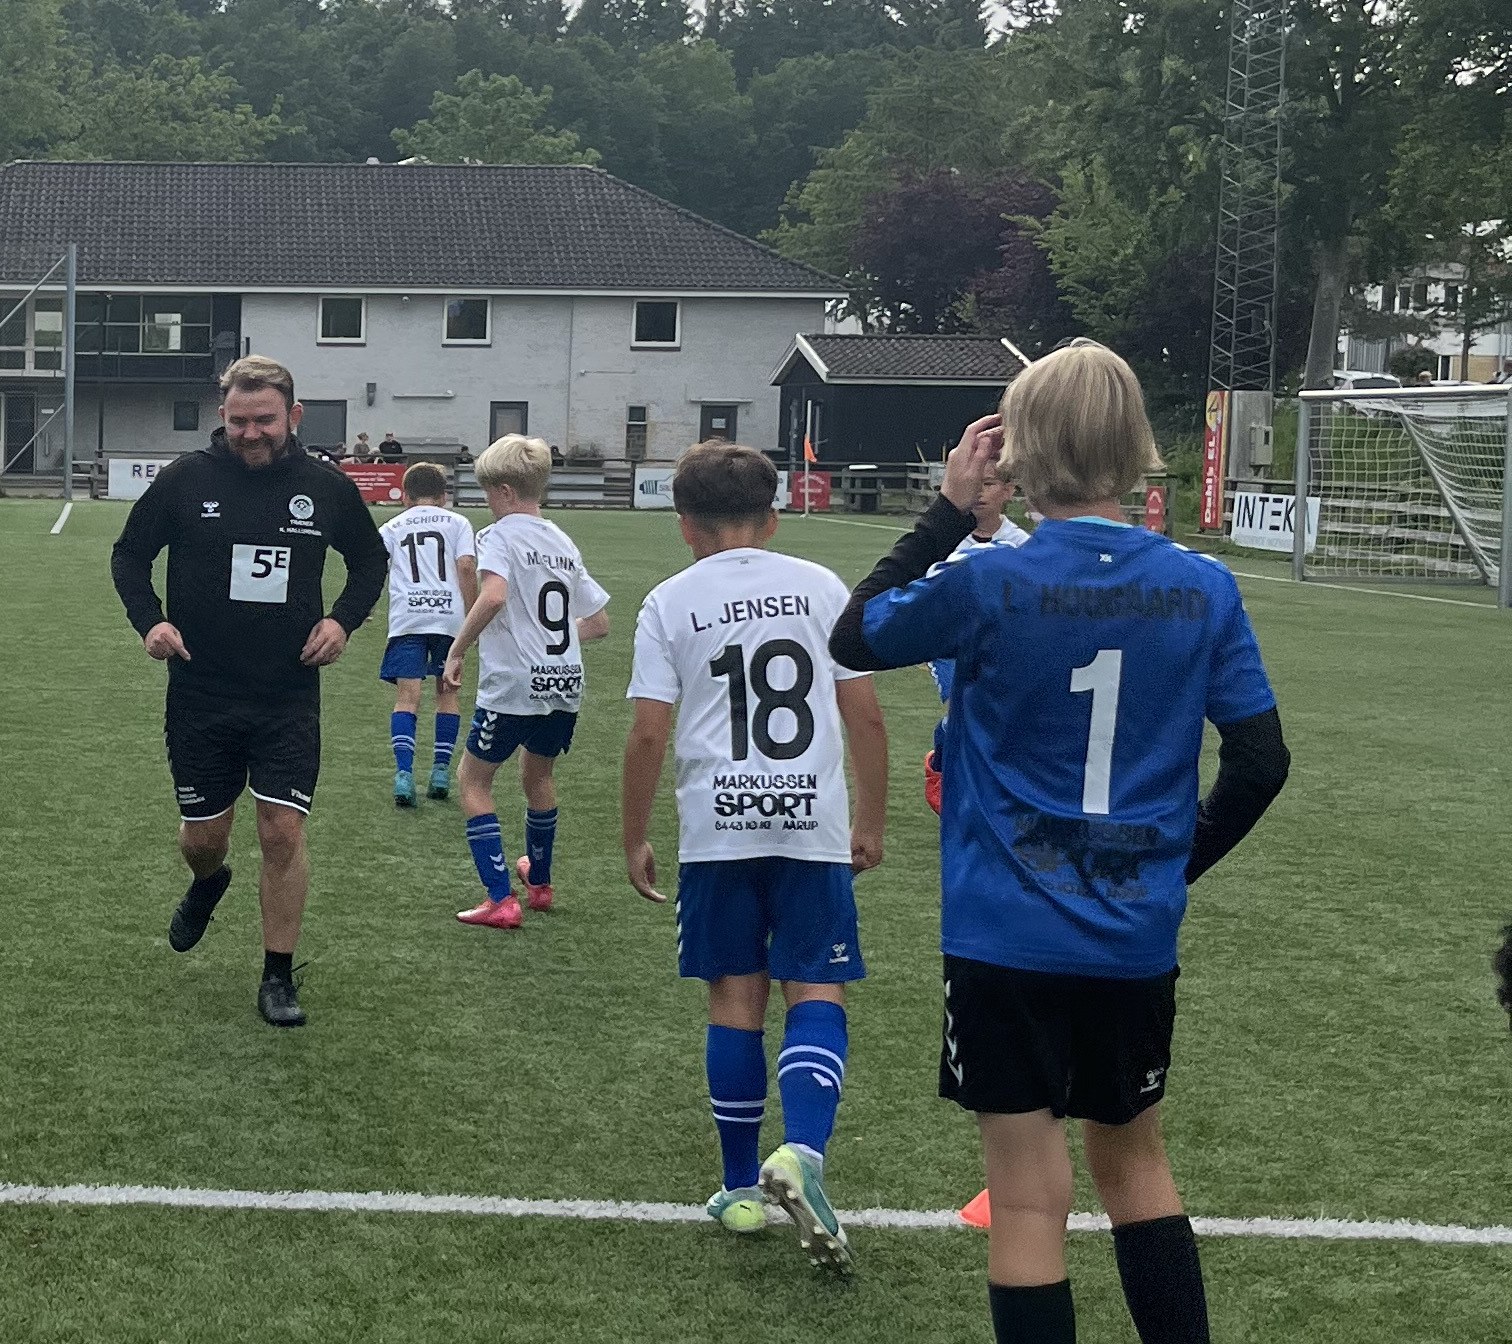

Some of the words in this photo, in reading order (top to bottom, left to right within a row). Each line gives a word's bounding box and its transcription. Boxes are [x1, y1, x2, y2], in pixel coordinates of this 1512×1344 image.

[132, 464, 163, 479] RE
[400, 530, 447, 584] 17
[408, 596, 453, 610] SPORT
[538, 581, 570, 655] 9
[690, 611, 713, 633] L.
[718, 596, 810, 625] JENSEN
[709, 638, 815, 761] 18
[1070, 648, 1124, 815] 1
[712, 773, 817, 791] MARKUSSEN
[713, 790, 818, 819] SPORT
[782, 820, 819, 831] AARUP
